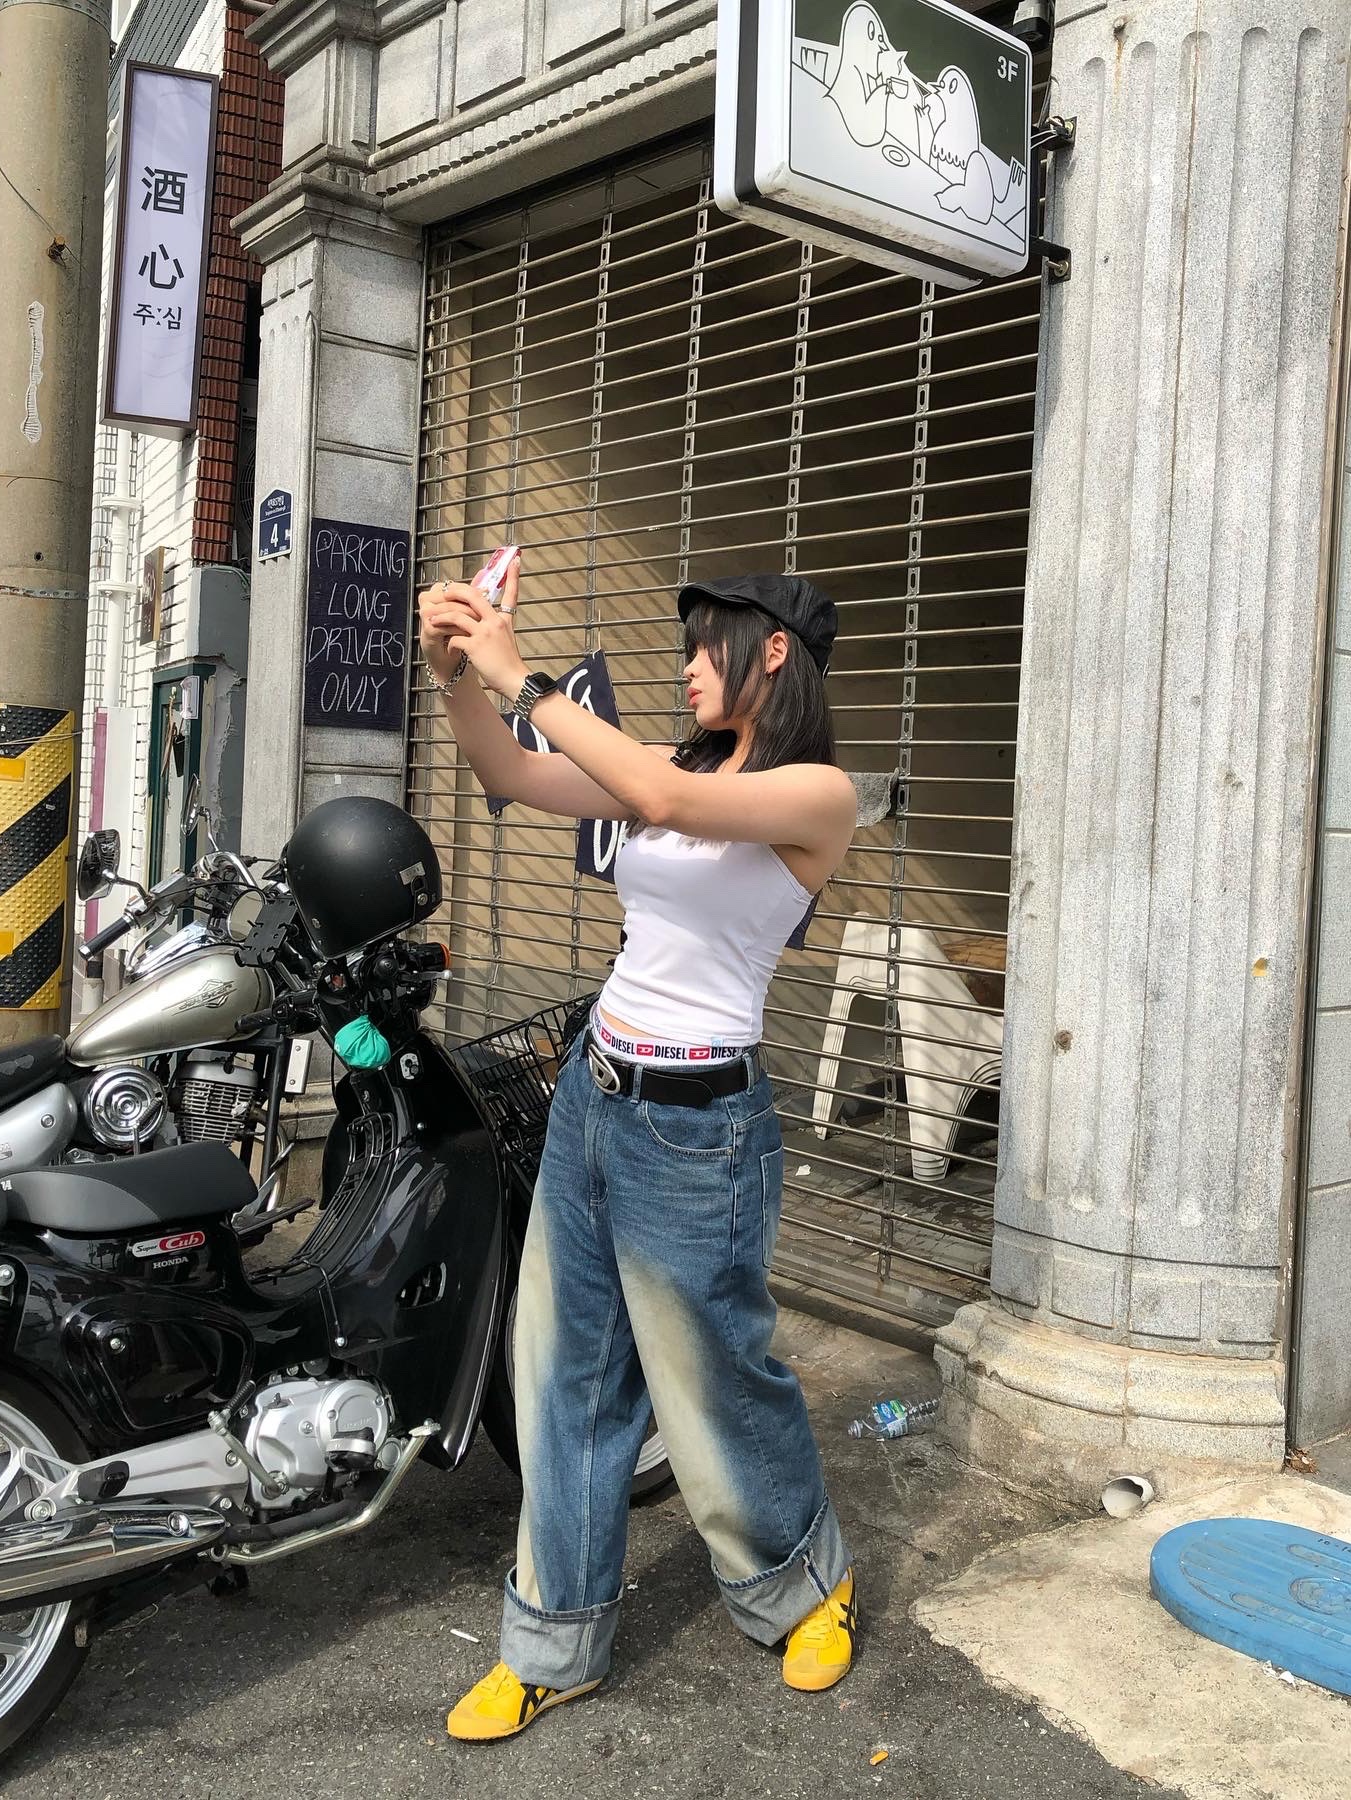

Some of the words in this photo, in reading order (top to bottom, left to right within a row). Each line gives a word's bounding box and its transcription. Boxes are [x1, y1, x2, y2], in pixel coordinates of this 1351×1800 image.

[999, 56, 1018, 83] 3F
[270, 523, 279, 547] 4
[315, 530, 407, 578] PARKING
[328, 583, 391, 623] LONG
[306, 627, 404, 668] DRIVERS
[321, 673, 387, 715] ONLY
[611, 1037, 635, 1055] DIESEL
[655, 1046, 687, 1060] DIESEL
[711, 1047, 742, 1059] DIESE
[136, 1245, 158, 1253] Super
[165, 1234, 198, 1249] Cub
[153, 1257, 189, 1269] HONDA
